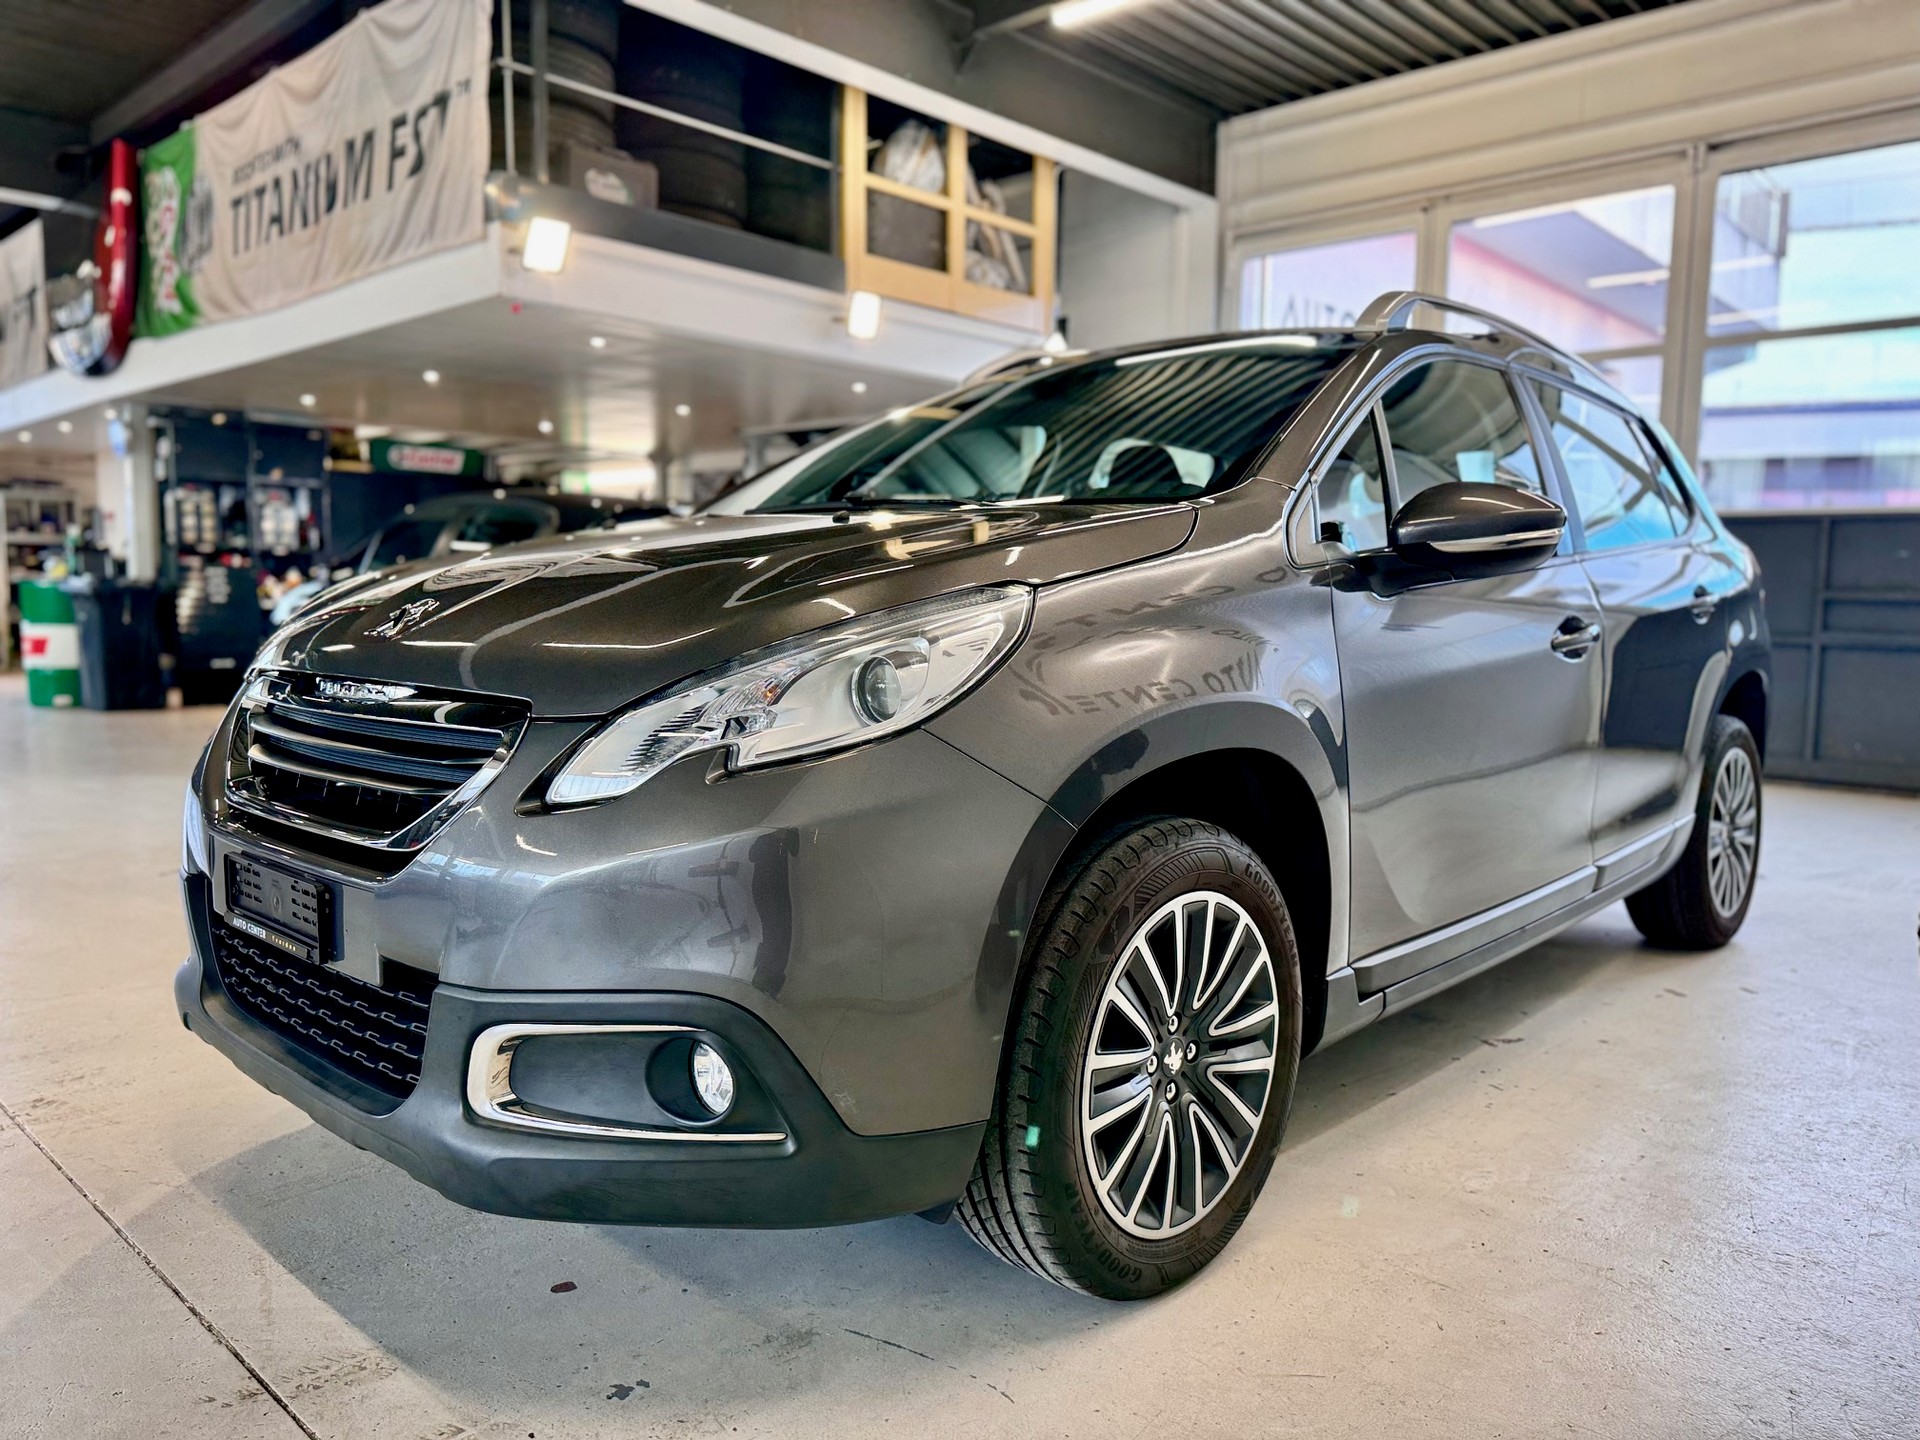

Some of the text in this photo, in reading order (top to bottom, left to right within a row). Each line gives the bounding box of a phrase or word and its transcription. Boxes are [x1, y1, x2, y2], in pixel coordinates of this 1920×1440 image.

[231, 127, 376, 256] TITANIUM
[232, 917, 247, 930] AUTO
[247, 923, 267, 939] CENTER
[1244, 862, 1298, 968] GOODYEAR
